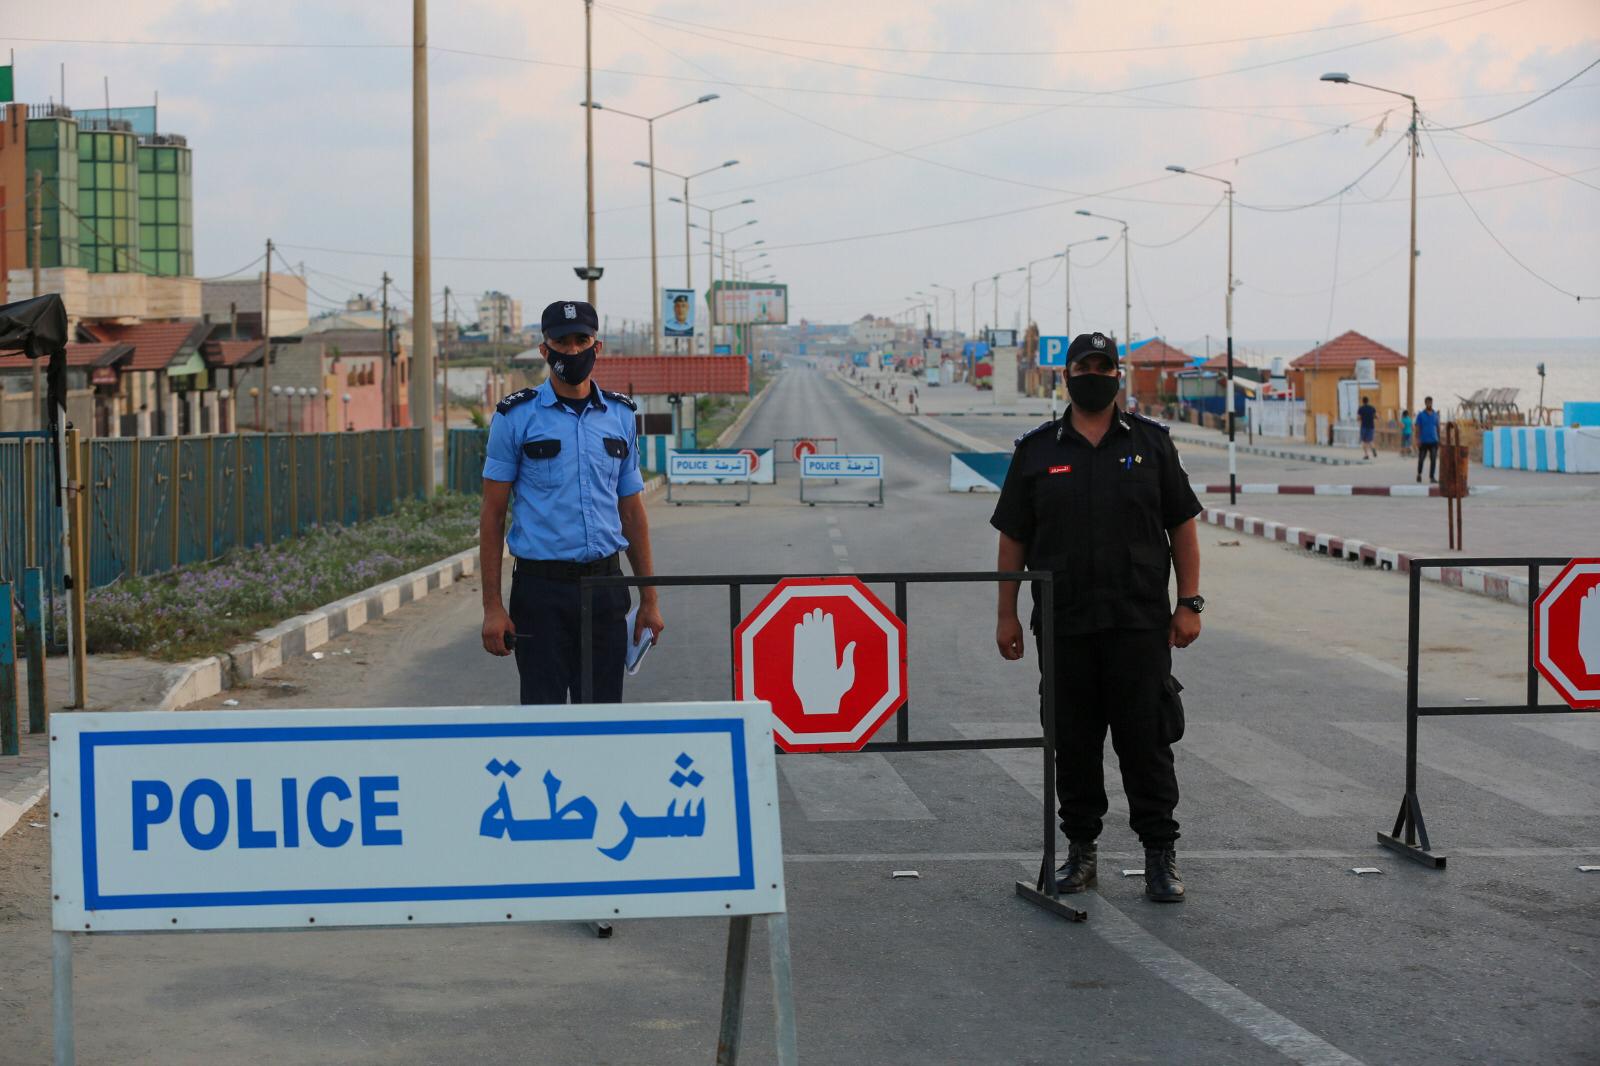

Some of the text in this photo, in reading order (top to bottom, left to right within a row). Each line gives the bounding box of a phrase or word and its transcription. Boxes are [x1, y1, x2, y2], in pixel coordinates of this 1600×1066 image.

[1047, 338, 1061, 363] P
[677, 461, 708, 470] POLICE
[715, 460, 741, 472] شرطة
[809, 461, 840, 471] POLICE
[847, 460, 874, 472] شرطة
[131, 775, 403, 852] POLICE
[480, 753, 706, 862] شرطة
